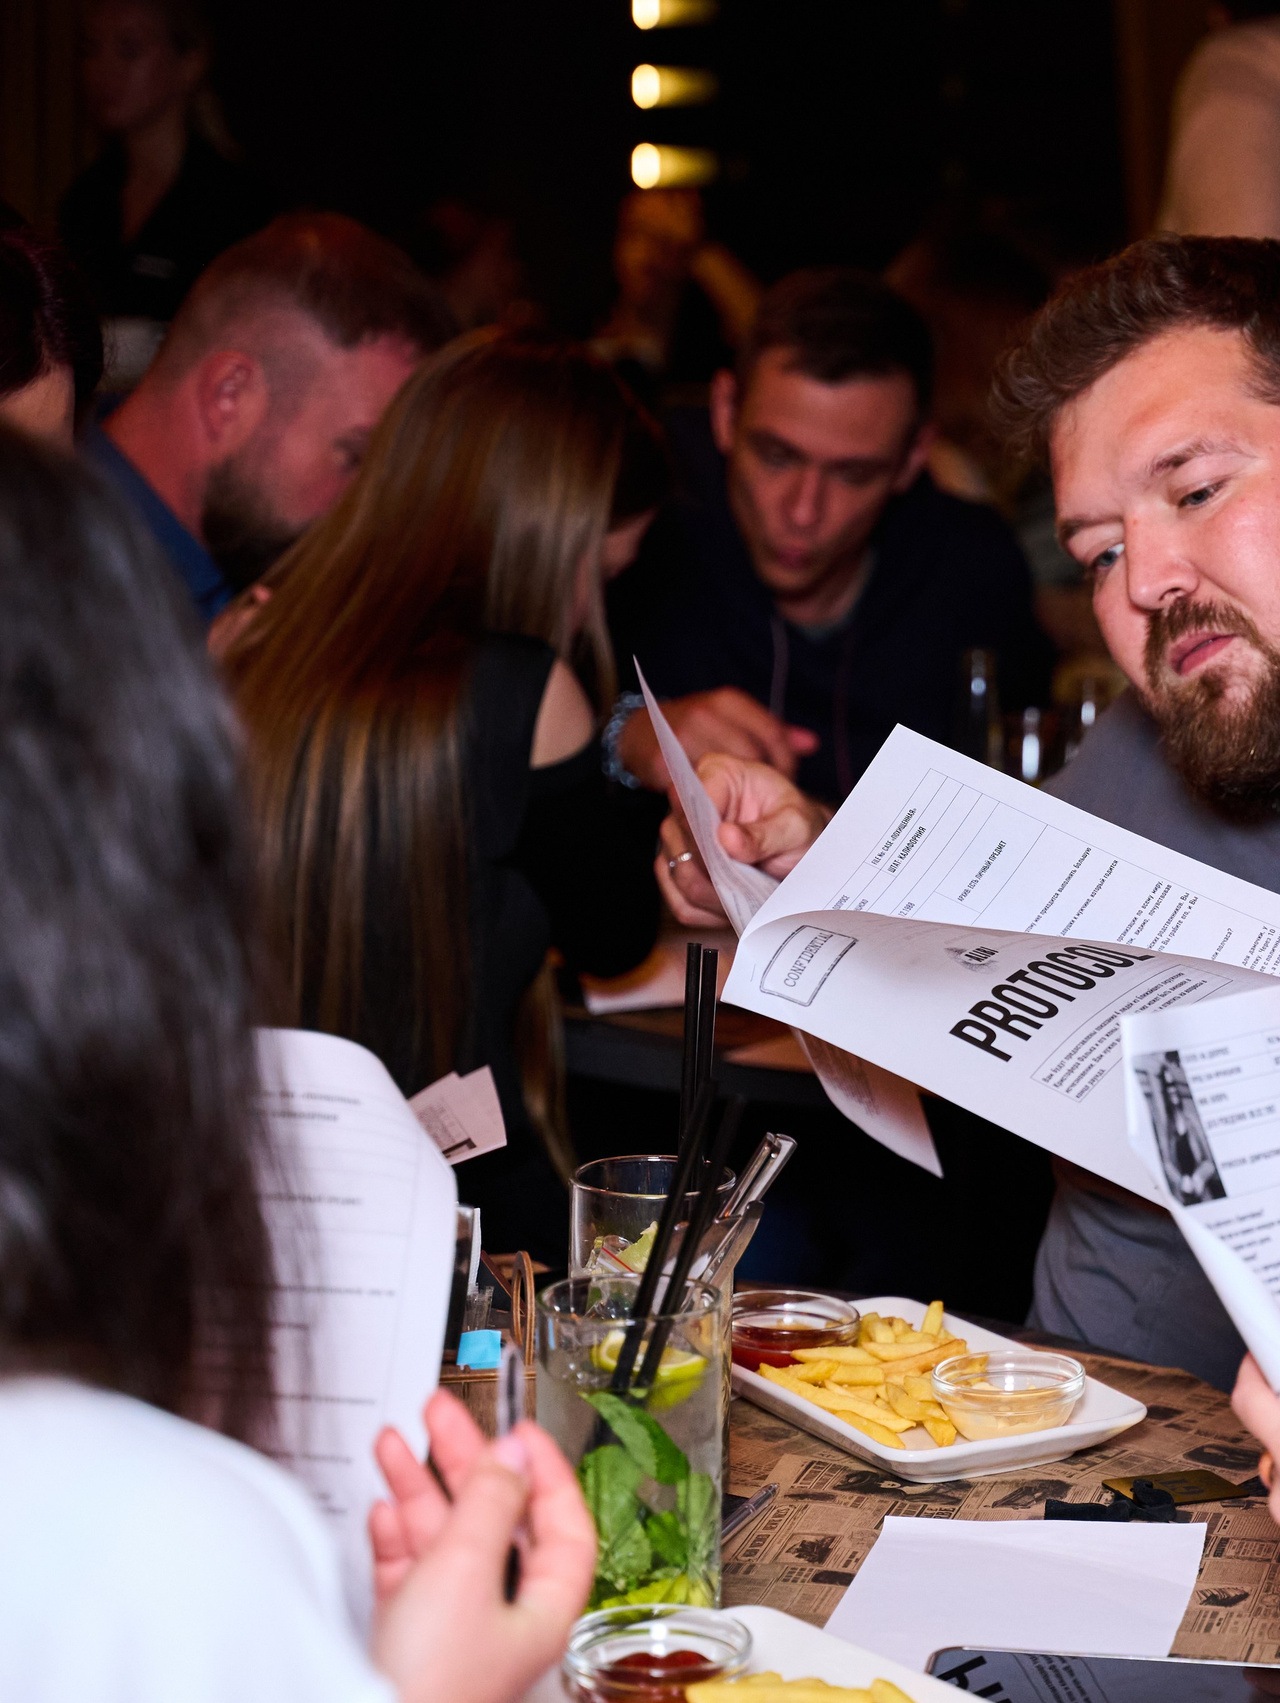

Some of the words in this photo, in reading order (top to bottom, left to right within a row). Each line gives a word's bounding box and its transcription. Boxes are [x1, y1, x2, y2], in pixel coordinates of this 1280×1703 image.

[882, 840, 894, 852] CASE
[887, 859, 902, 873] ШТАТ:
[897, 826, 927, 860] КАЛИФОРНИЯ
[975, 860, 993, 880] ЛИЧНЫЙ
[988, 840, 1007, 862] ПРЕДМЕТ
[1073, 847, 1092, 869] большую
[783, 932, 834, 988] CONFIDENTIAL
[949, 944, 1155, 1062] PROTOCOL
